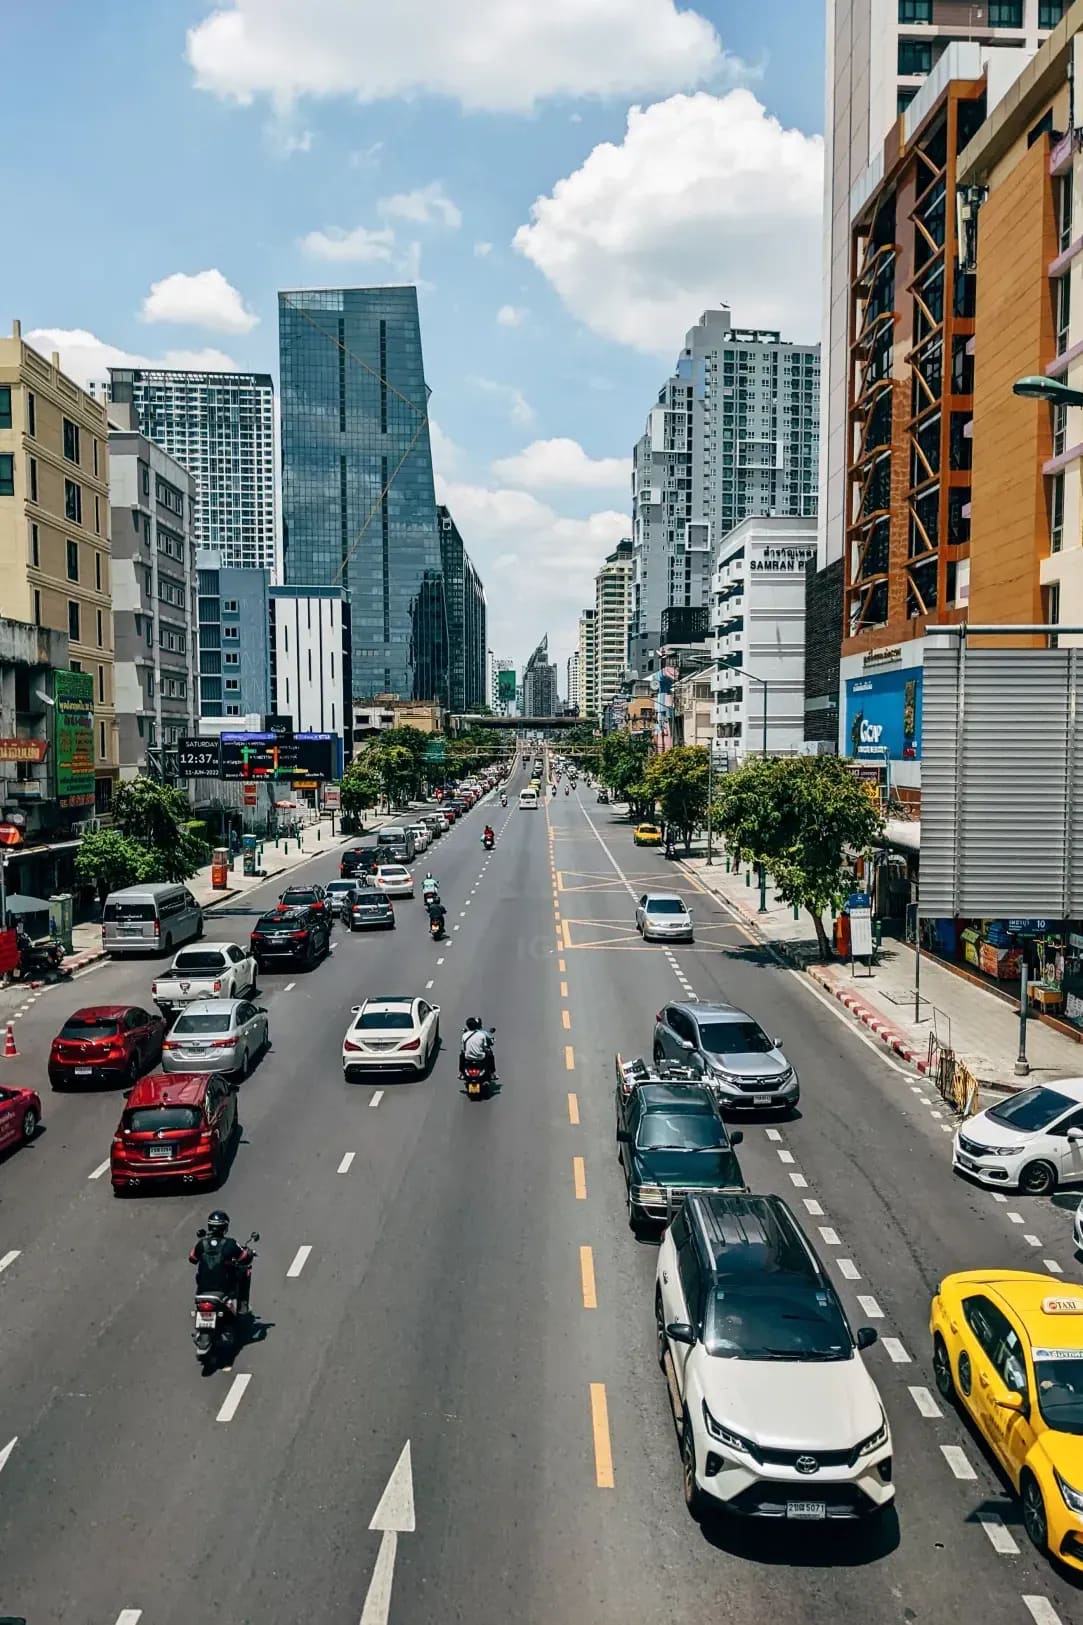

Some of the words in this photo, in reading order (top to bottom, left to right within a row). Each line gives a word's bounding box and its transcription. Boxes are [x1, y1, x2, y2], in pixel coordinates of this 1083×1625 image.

[763, 545, 817, 559] สำราญเพล
[750, 560, 794, 570] SAMRAN
[180, 753, 212, 764] 12:37
[1037, 920, 1046, 928] 10
[1056, 1302, 1076, 1310] TAXI
[806, 1503, 824, 1512] 5071
